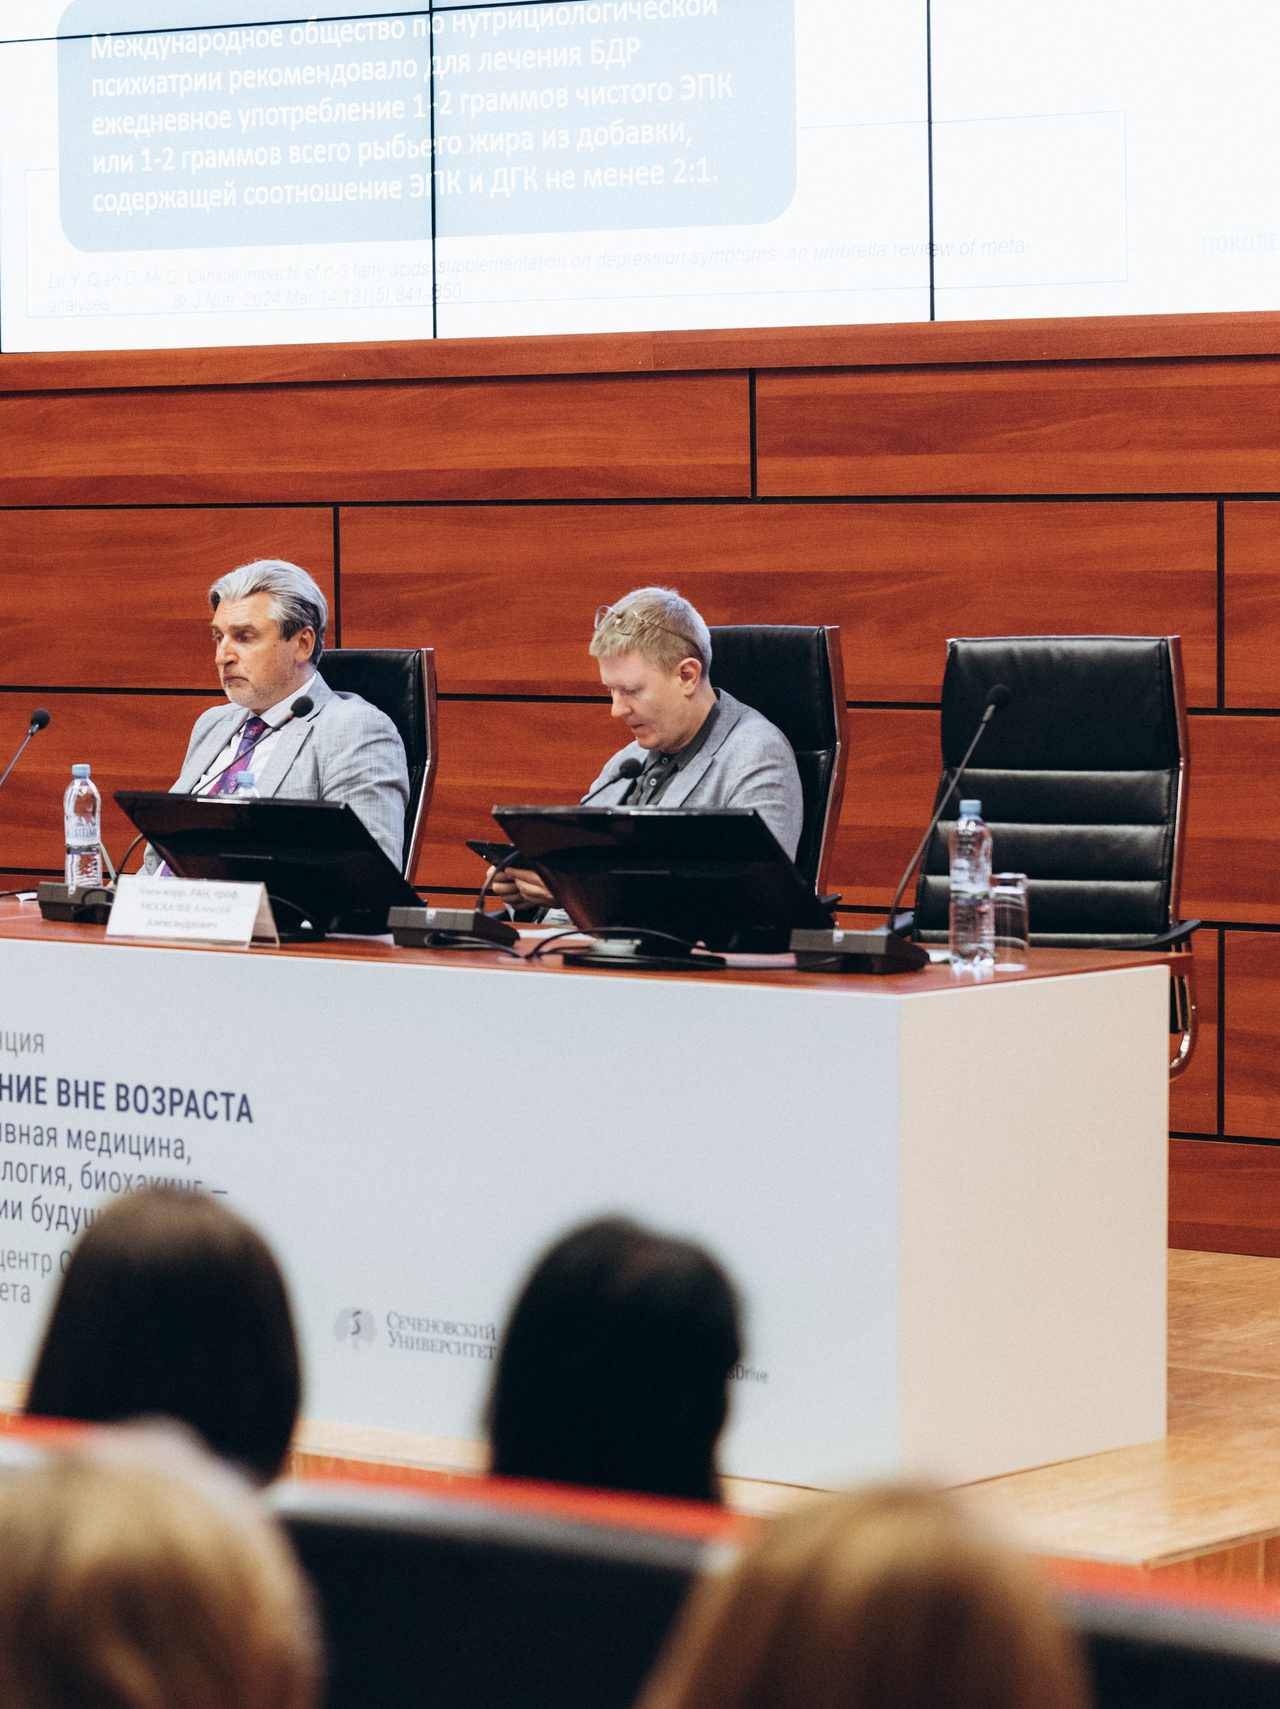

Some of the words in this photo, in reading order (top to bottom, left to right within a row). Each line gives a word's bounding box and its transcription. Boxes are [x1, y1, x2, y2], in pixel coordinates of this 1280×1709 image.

[91, 26, 284, 62] Международное
[288, 15, 406, 49] общество
[412, 17, 445, 38] по
[452, 0, 718, 37] нутрициологической
[91, 66, 222, 98] психиатрии
[228, 56, 418, 95] рекомендовало
[423, 51, 471, 80] для
[477, 45, 584, 72] лечения
[590, 37, 641, 71] БДР
[91, 103, 232, 138] ежедневное
[238, 95, 406, 134] употребление
[412, 92, 454, 119] 1-2
[459, 87, 570, 120] граммов
[575, 79, 674, 107] чистого
[680, 72, 734, 101] ЭПК
[91, 147, 136, 175] или
[140, 144, 176, 172] 1-2
[181, 139, 283, 173] граммов
[288, 137, 352, 163] всего
[357, 127, 463, 164] рыбьего
[468, 123, 535, 155] жира
[542, 122, 572, 147] из
[577, 112, 693, 149] добавки,
[91, 181, 237, 217] содержащей
[243, 176, 402, 209] соотношение
[409, 171, 462, 198] ЭПК
[468, 174, 485, 195] и
[490, 164, 538, 199] ДГК
[545, 166, 576, 190] не
[583, 163, 665, 188] менее
[671, 156, 719, 186] 2:1.
[187, 266, 239, 284] Clinical
[244, 265, 300, 286] impacts
[305, 263, 319, 280] of
[323, 262, 348, 279] n-3
[352, 261, 384, 282] fatty
[437, 254, 566, 278] supplementation
[571, 253, 591, 269] on
[596, 247, 685, 271] depression
[787, 245, 808, 261] an
[814, 240, 886, 260] umbrella
[892, 238, 954, 257] review
[959, 238, 977, 256] of
[981, 236, 1032, 256] meta-
[48, 297, 110, 316] analyses
[245, 289, 280, 308] 2024
[285, 288, 314, 306] Mar
[56, 1078, 107, 1110] ВНЕ
[115, 1082, 254, 1124] ВОЗРАСТА
[67, 1128, 192, 1165] медицина,
